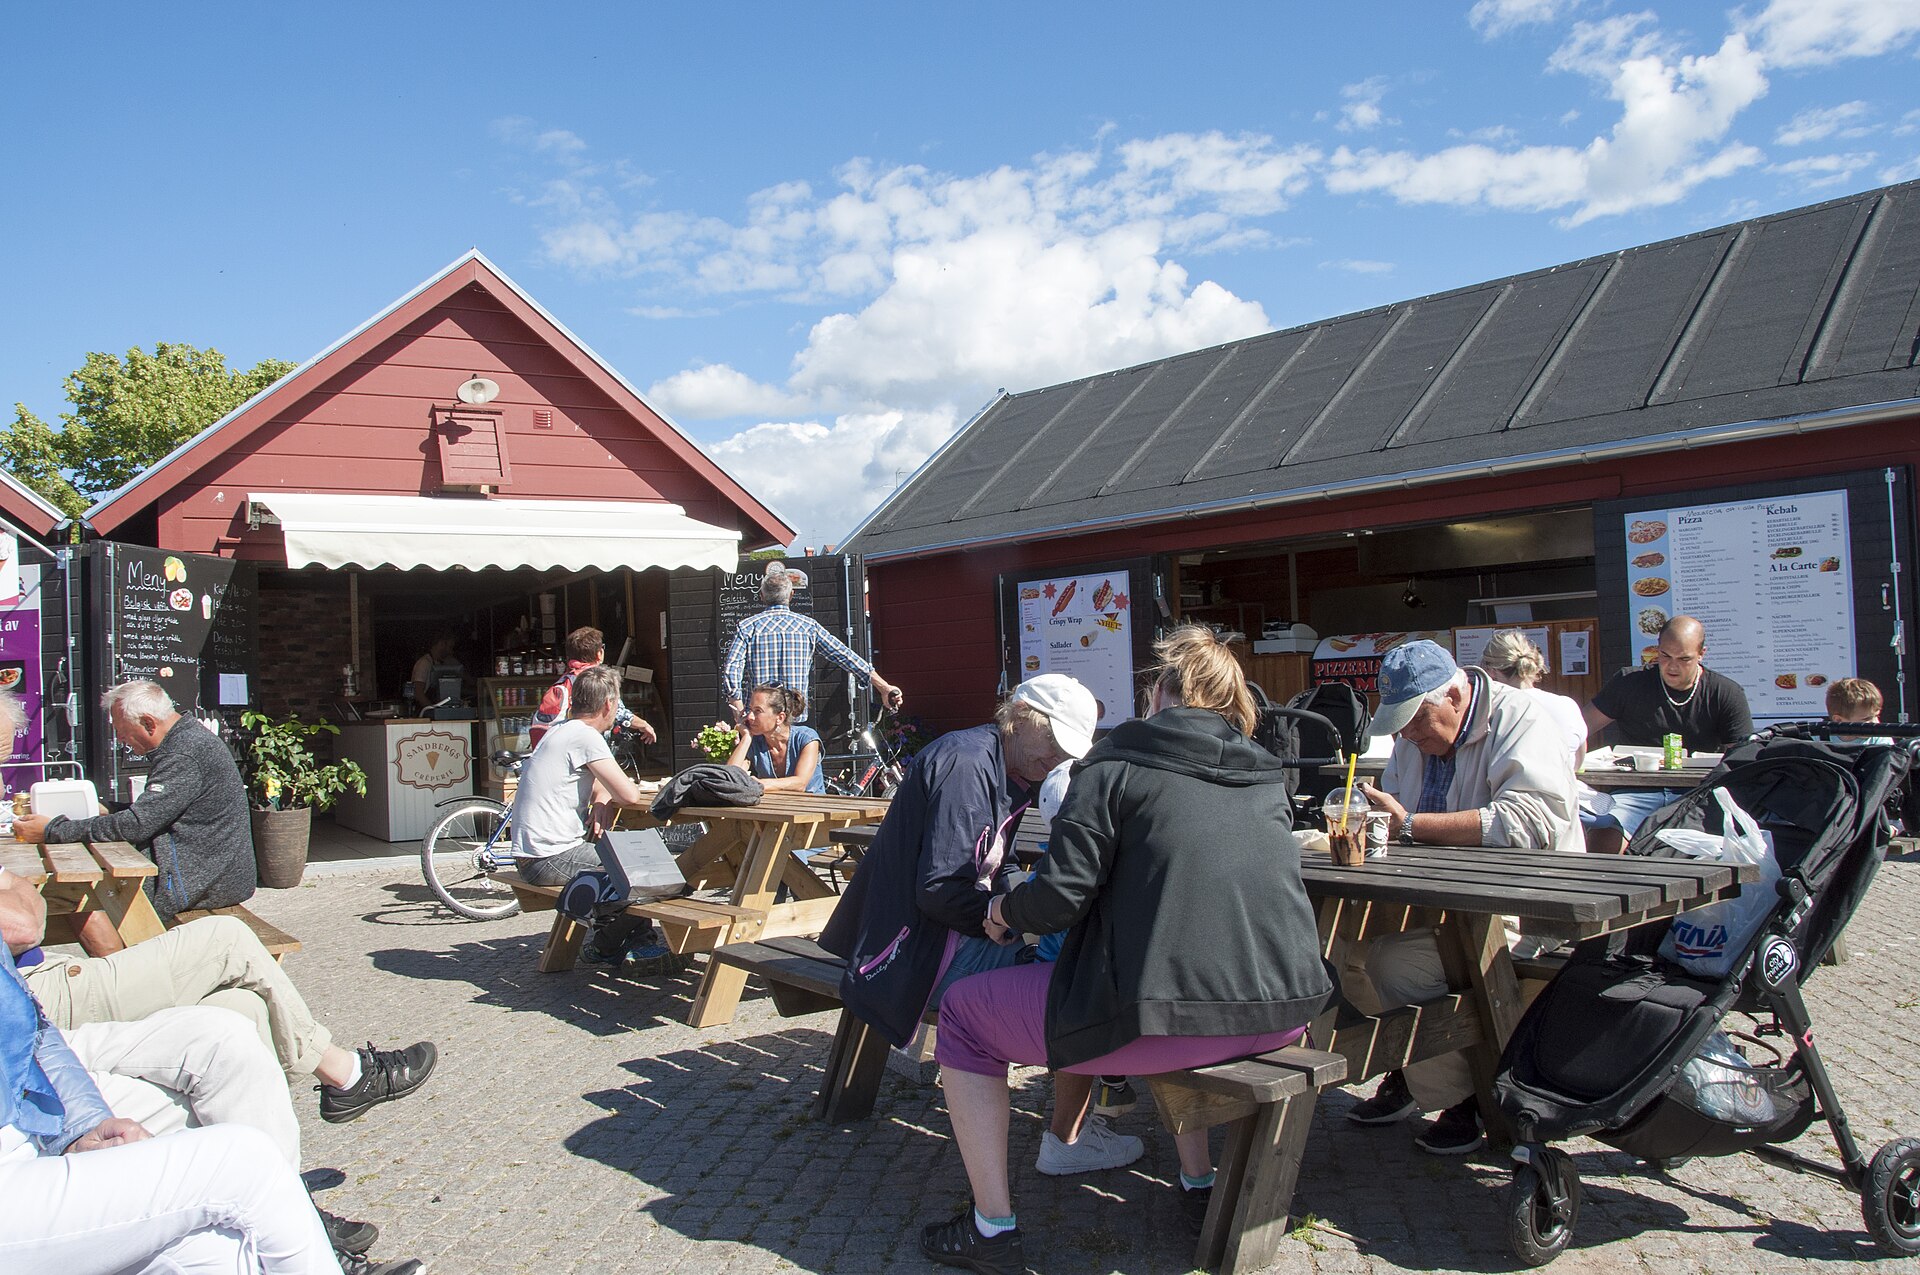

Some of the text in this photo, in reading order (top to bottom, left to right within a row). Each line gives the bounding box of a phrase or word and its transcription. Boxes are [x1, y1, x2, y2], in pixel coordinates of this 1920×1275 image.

[1766, 504, 1798, 516] Kebab
[1678, 516, 1703, 525] Pizza
[1769, 561, 1819, 572] A la Carte
[128, 560, 167, 599] Meny
[723, 571, 764, 594] Meny
[123, 594, 153, 613] Belgisk
[5, 621, 20, 632] av
[1049, 616, 1083, 627] Crispy Wrap
[1049, 640, 1073, 650] Sallader
[1313, 659, 1381, 677] PIZZERIA
[406, 742, 461, 760] SANDBERGS
[414, 768, 455, 782] CRÊPERIE
